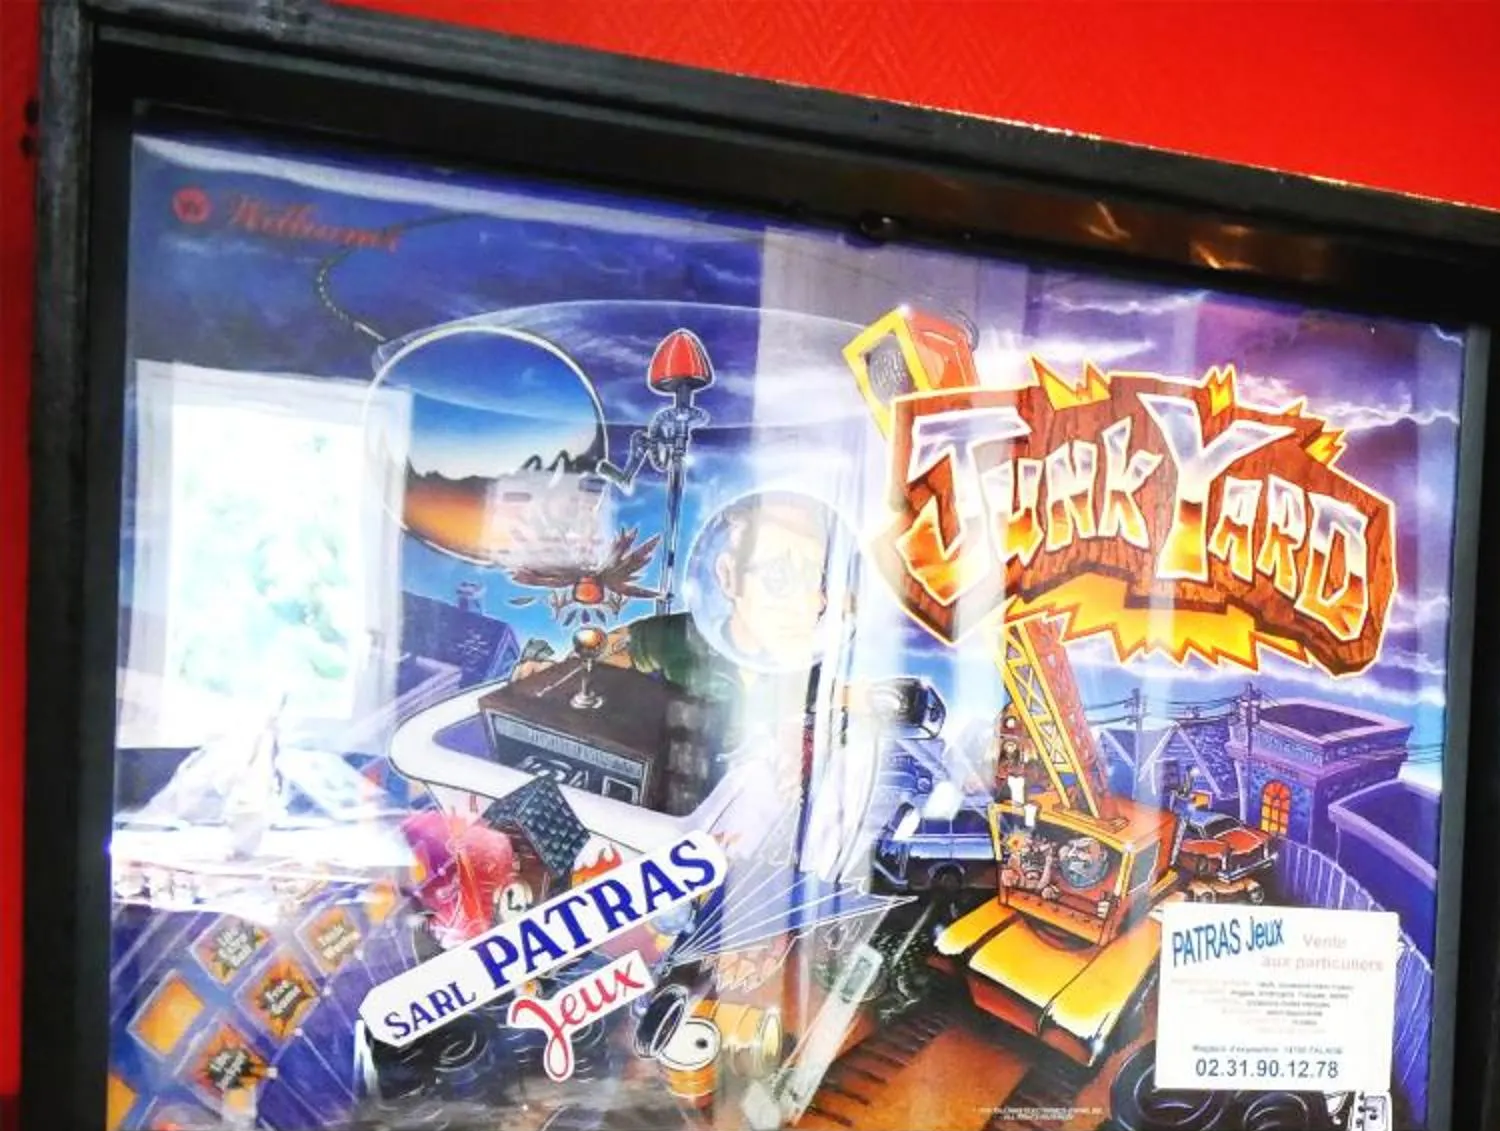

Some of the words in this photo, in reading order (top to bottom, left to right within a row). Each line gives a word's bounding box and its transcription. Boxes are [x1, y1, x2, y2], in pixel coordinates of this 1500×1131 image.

[384, 980, 476, 1039] SARL
[471, 840, 715, 991] PATRAS
[1172, 918, 1241, 968] PATRAS
[1246, 916, 1285, 950] Jeux
[512, 960, 646, 1079] Jeux
[1195, 1058, 1340, 1079] 02.31.90.12.78
